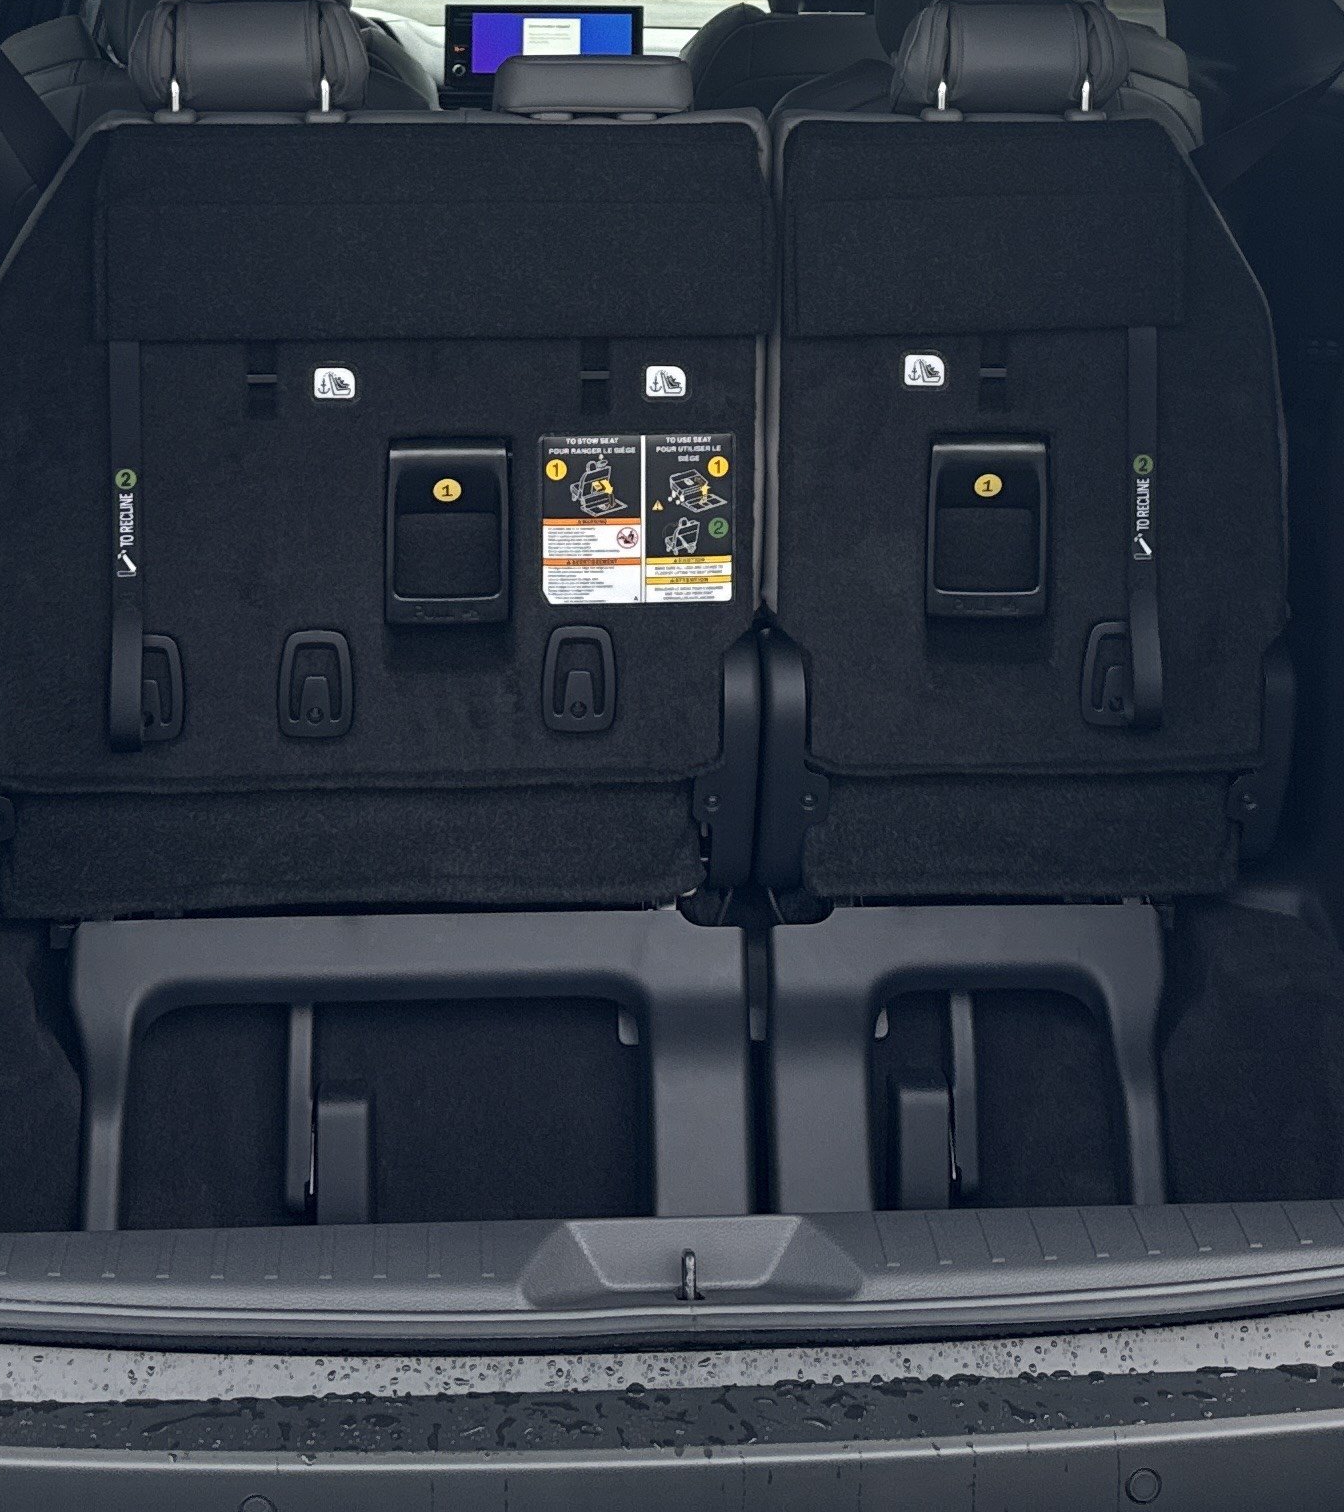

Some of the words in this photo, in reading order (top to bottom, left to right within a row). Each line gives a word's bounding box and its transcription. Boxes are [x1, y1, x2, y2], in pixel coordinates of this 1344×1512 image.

[577, 437, 598, 445] STOW
[600, 437, 619, 445] SEAT
[1139, 457, 1148, 472] 2
[121, 471, 131, 486] 2
[442, 484, 453, 496] 1
[982, 480, 993, 492] 1
[1136, 478, 1150, 518] RECLINE
[119, 492, 134, 533] RECLINE
[713, 520, 724, 535] 2
[1136, 518, 1150, 531] TO
[119, 534, 134, 548] TO
